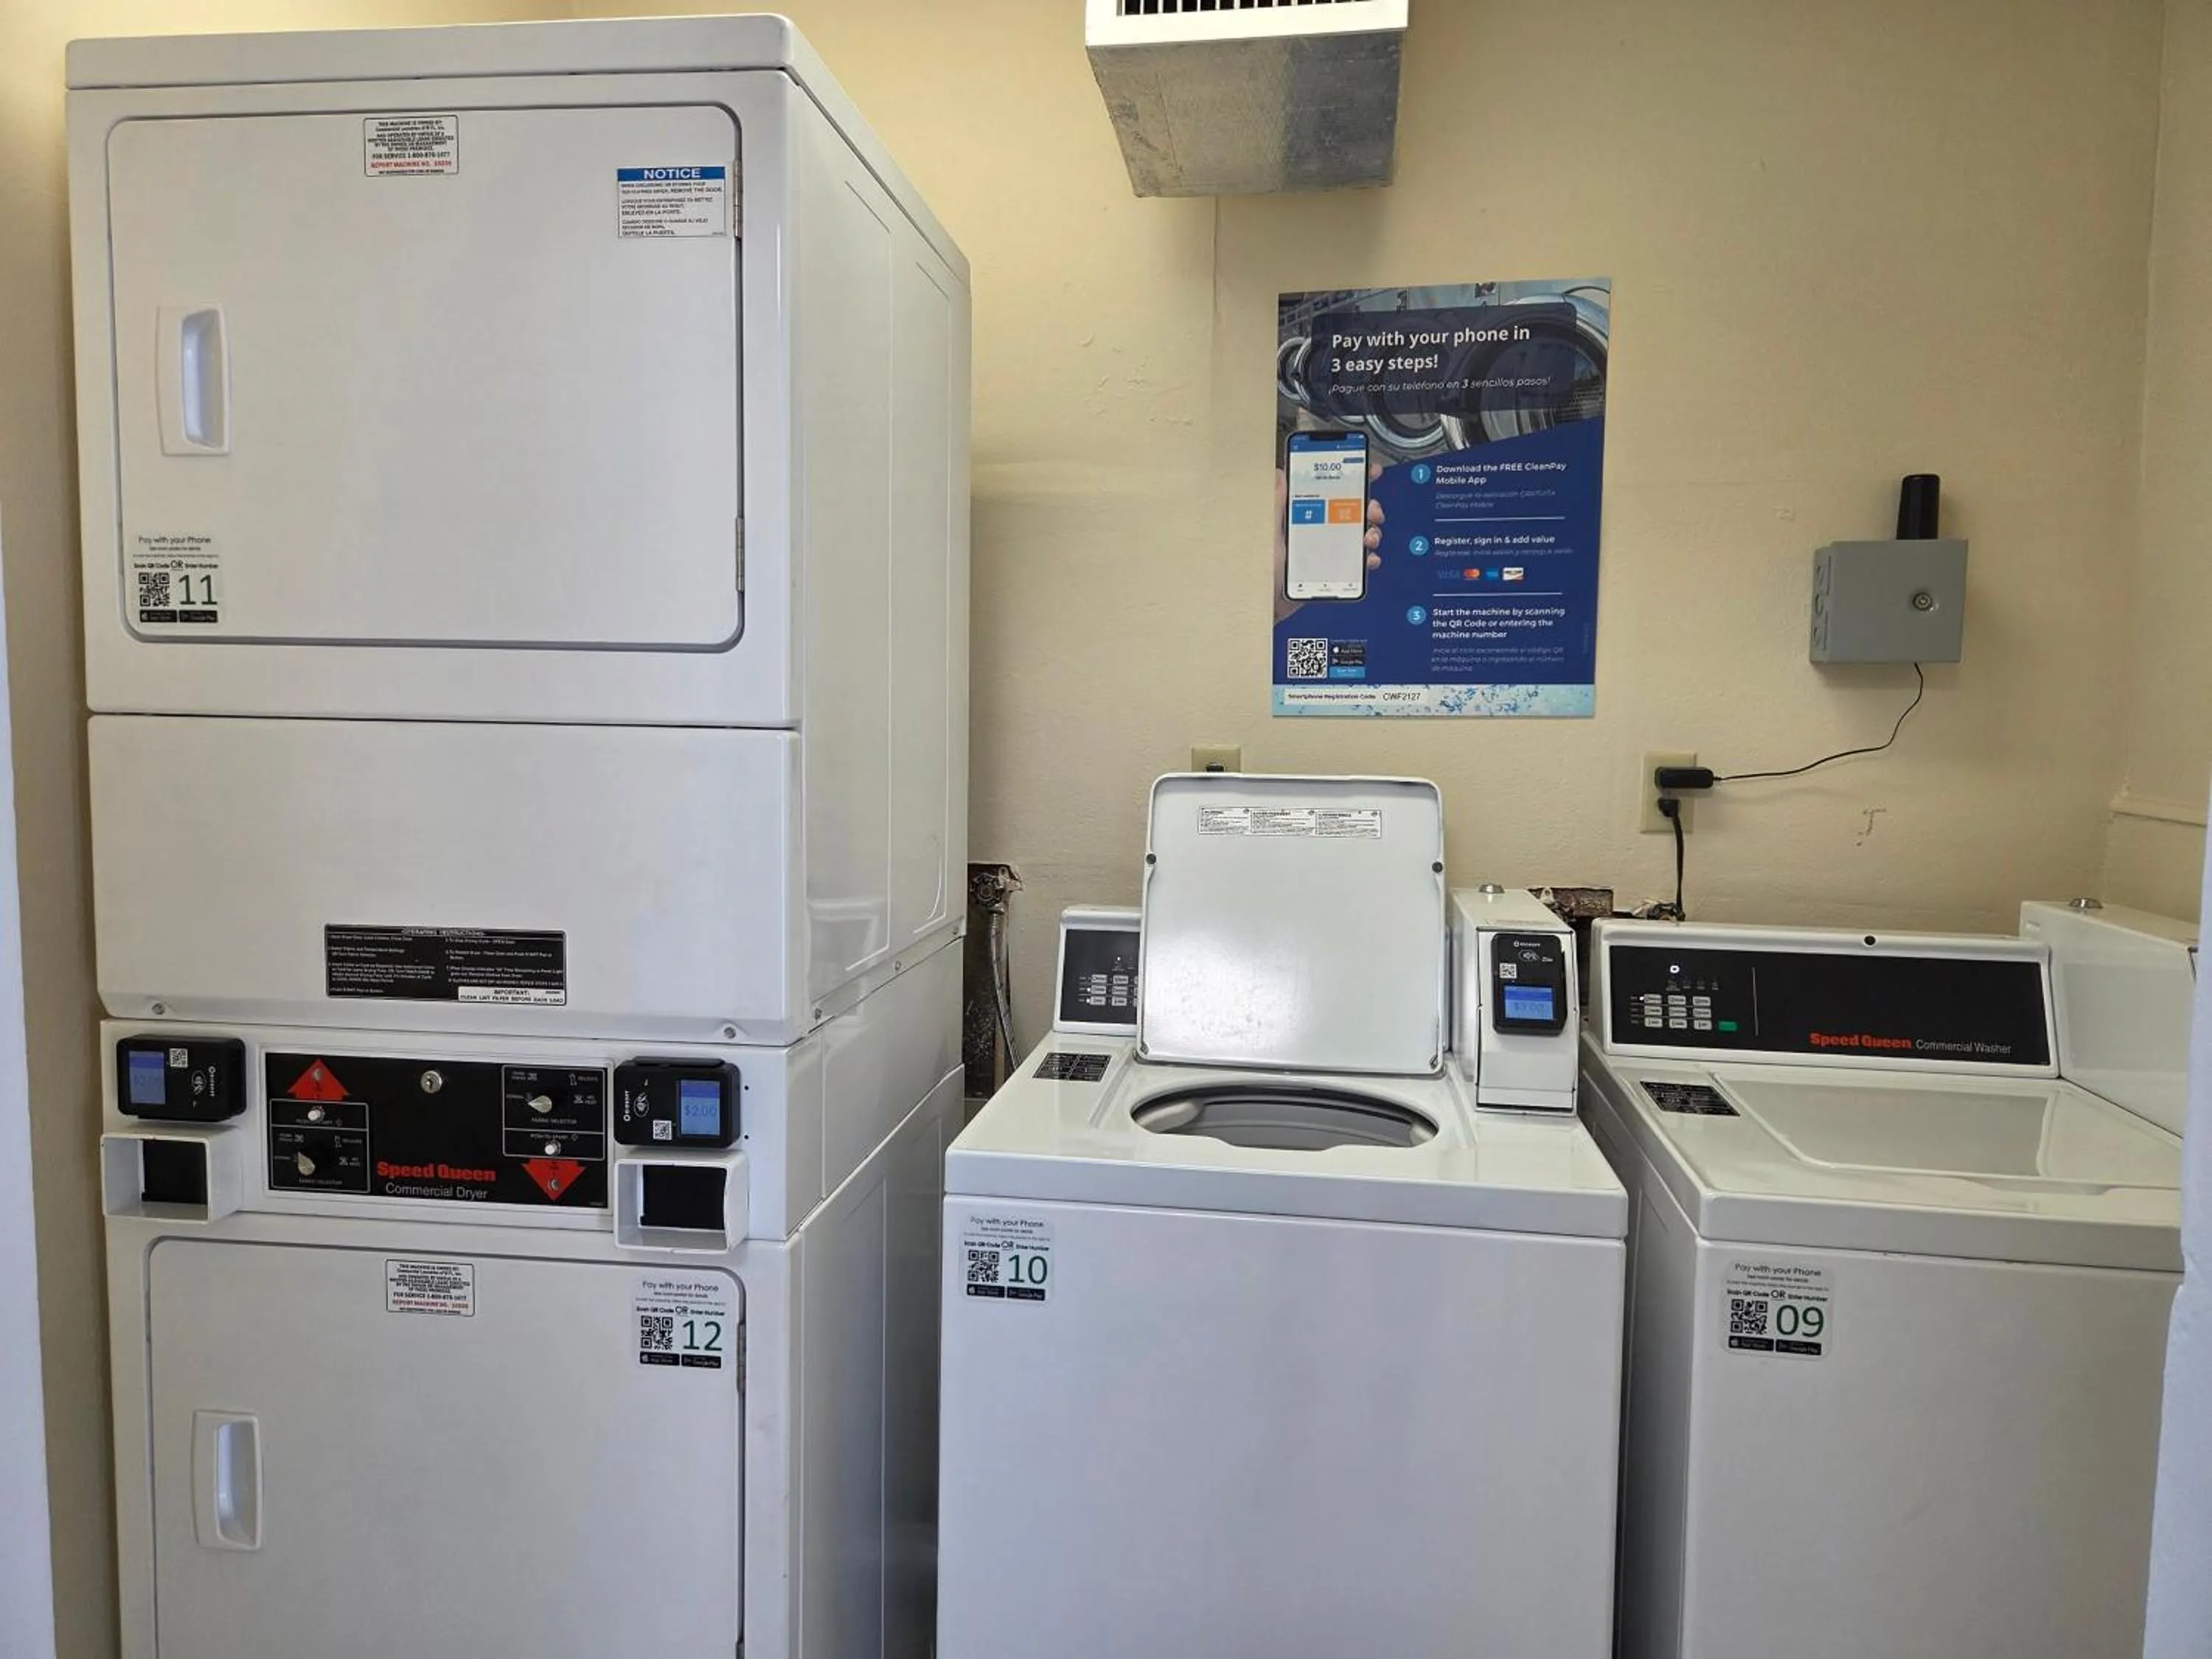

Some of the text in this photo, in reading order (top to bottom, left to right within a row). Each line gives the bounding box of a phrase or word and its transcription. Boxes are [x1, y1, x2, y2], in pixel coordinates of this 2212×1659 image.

[644, 168, 700, 179] NOTICE
[1332, 325, 1530, 352] Pay with your phone in
[1331, 354, 1439, 375] 3 easy steps!
[1367, 383, 1386, 392] con
[1388, 383, 1401, 392] su
[1447, 381, 1460, 389] en
[1461, 379, 1469, 389] 3
[1470, 378, 1514, 388] sencillos
[1516, 377, 1551, 388] pasos!
[1436, 462, 1568, 473] Download the FREE CleanPay
[1419, 468, 1423, 479] 1
[1436, 476, 1488, 486] Mobile App
[139, 536, 152, 544] Pay
[170, 538, 185, 546] your
[1415, 540, 1423, 551] 2
[1434, 538, 1472, 546] Register,
[1475, 537, 1494, 546] sign
[1512, 535, 1530, 544] add
[1531, 535, 1555, 543] value
[178, 574, 218, 605] 11
[1413, 611, 1420, 620] 3
[1512, 608, 1523, 617] by
[1524, 608, 1566, 617] scanning
[1449, 620, 1462, 628] QR
[1499, 619, 1537, 628] entering
[1382, 692, 1421, 700] CWF2127
[1809, 1033, 2011, 1054] Speed Queen Commercial Washer
[685, 1105, 717, 1117] $2.00
[377, 1161, 496, 1181] Speed Queen
[386, 1182, 488, 1200] Commercial Dryer
[1001, 1240, 1015, 1248] OR
[1008, 1255, 1047, 1284] 10
[1735, 1263, 1750, 1272] Pay
[1753, 1265, 1770, 1273] with
[1793, 1267, 1821, 1276] Phone
[643, 1281, 656, 1289] Pay
[676, 1284, 692, 1292] your
[694, 1284, 719, 1292] Phone
[1771, 1290, 1786, 1298] OR
[675, 1306, 689, 1314] OR
[1776, 1304, 1824, 1338] 09
[682, 1320, 723, 1351] 12
